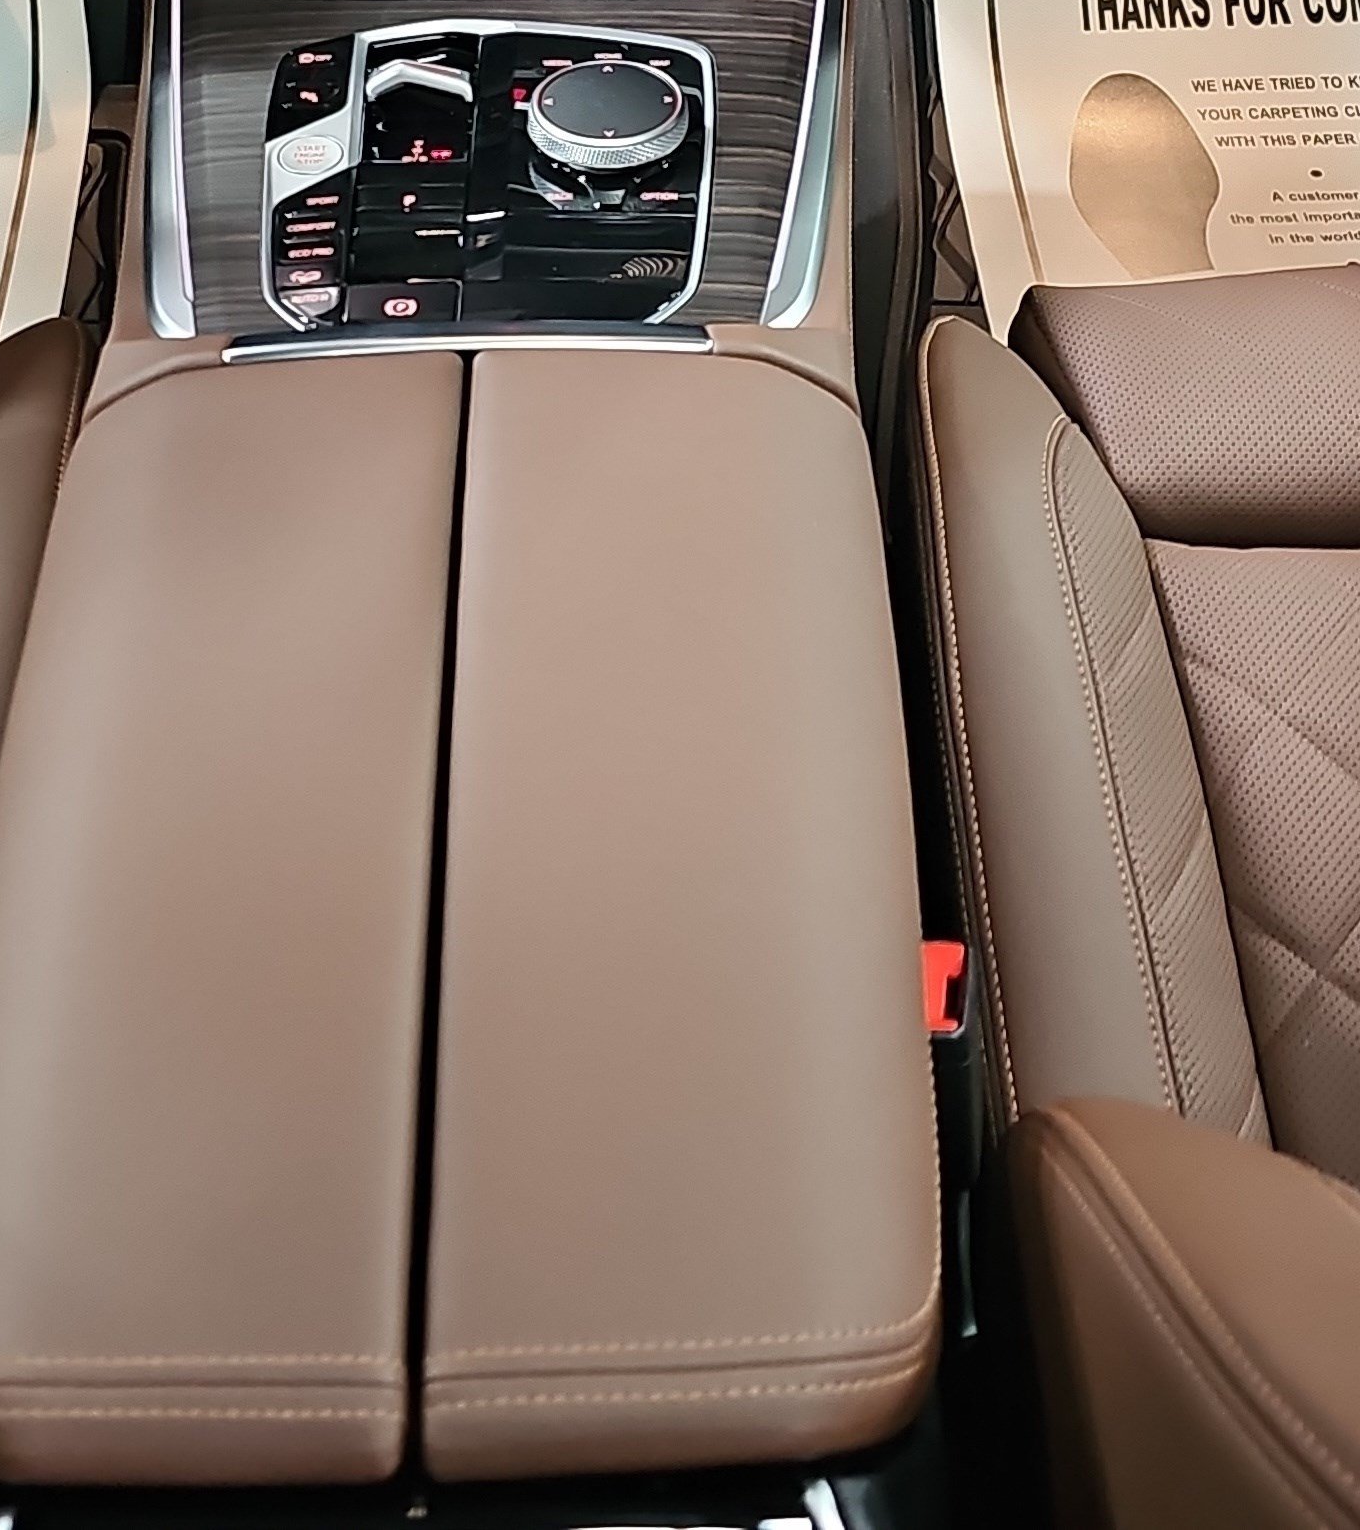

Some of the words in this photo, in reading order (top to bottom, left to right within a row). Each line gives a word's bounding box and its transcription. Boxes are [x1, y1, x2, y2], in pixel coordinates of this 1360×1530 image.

[1191, 79, 1217, 93] WE
[1222, 77, 1265, 91] HAVE
[1269, 76, 1316, 91] TRIED
[1320, 75, 1343, 89] TO
[1196, 107, 1243, 121] YOUR
[1248, 105, 1339, 120] CARPETING
[1215, 135, 1256, 148] WITH
[1260, 134, 1297, 147] THIS
[1302, 133, 1357, 146] PAPER
[1272, 191, 1284, 202] A
[1289, 190, 1359, 202] customer
[1230, 213, 1254, 225] the
[1260, 212, 1299, 224] most
[1269, 233, 1284, 244] in
[1289, 233, 1314, 244] the
